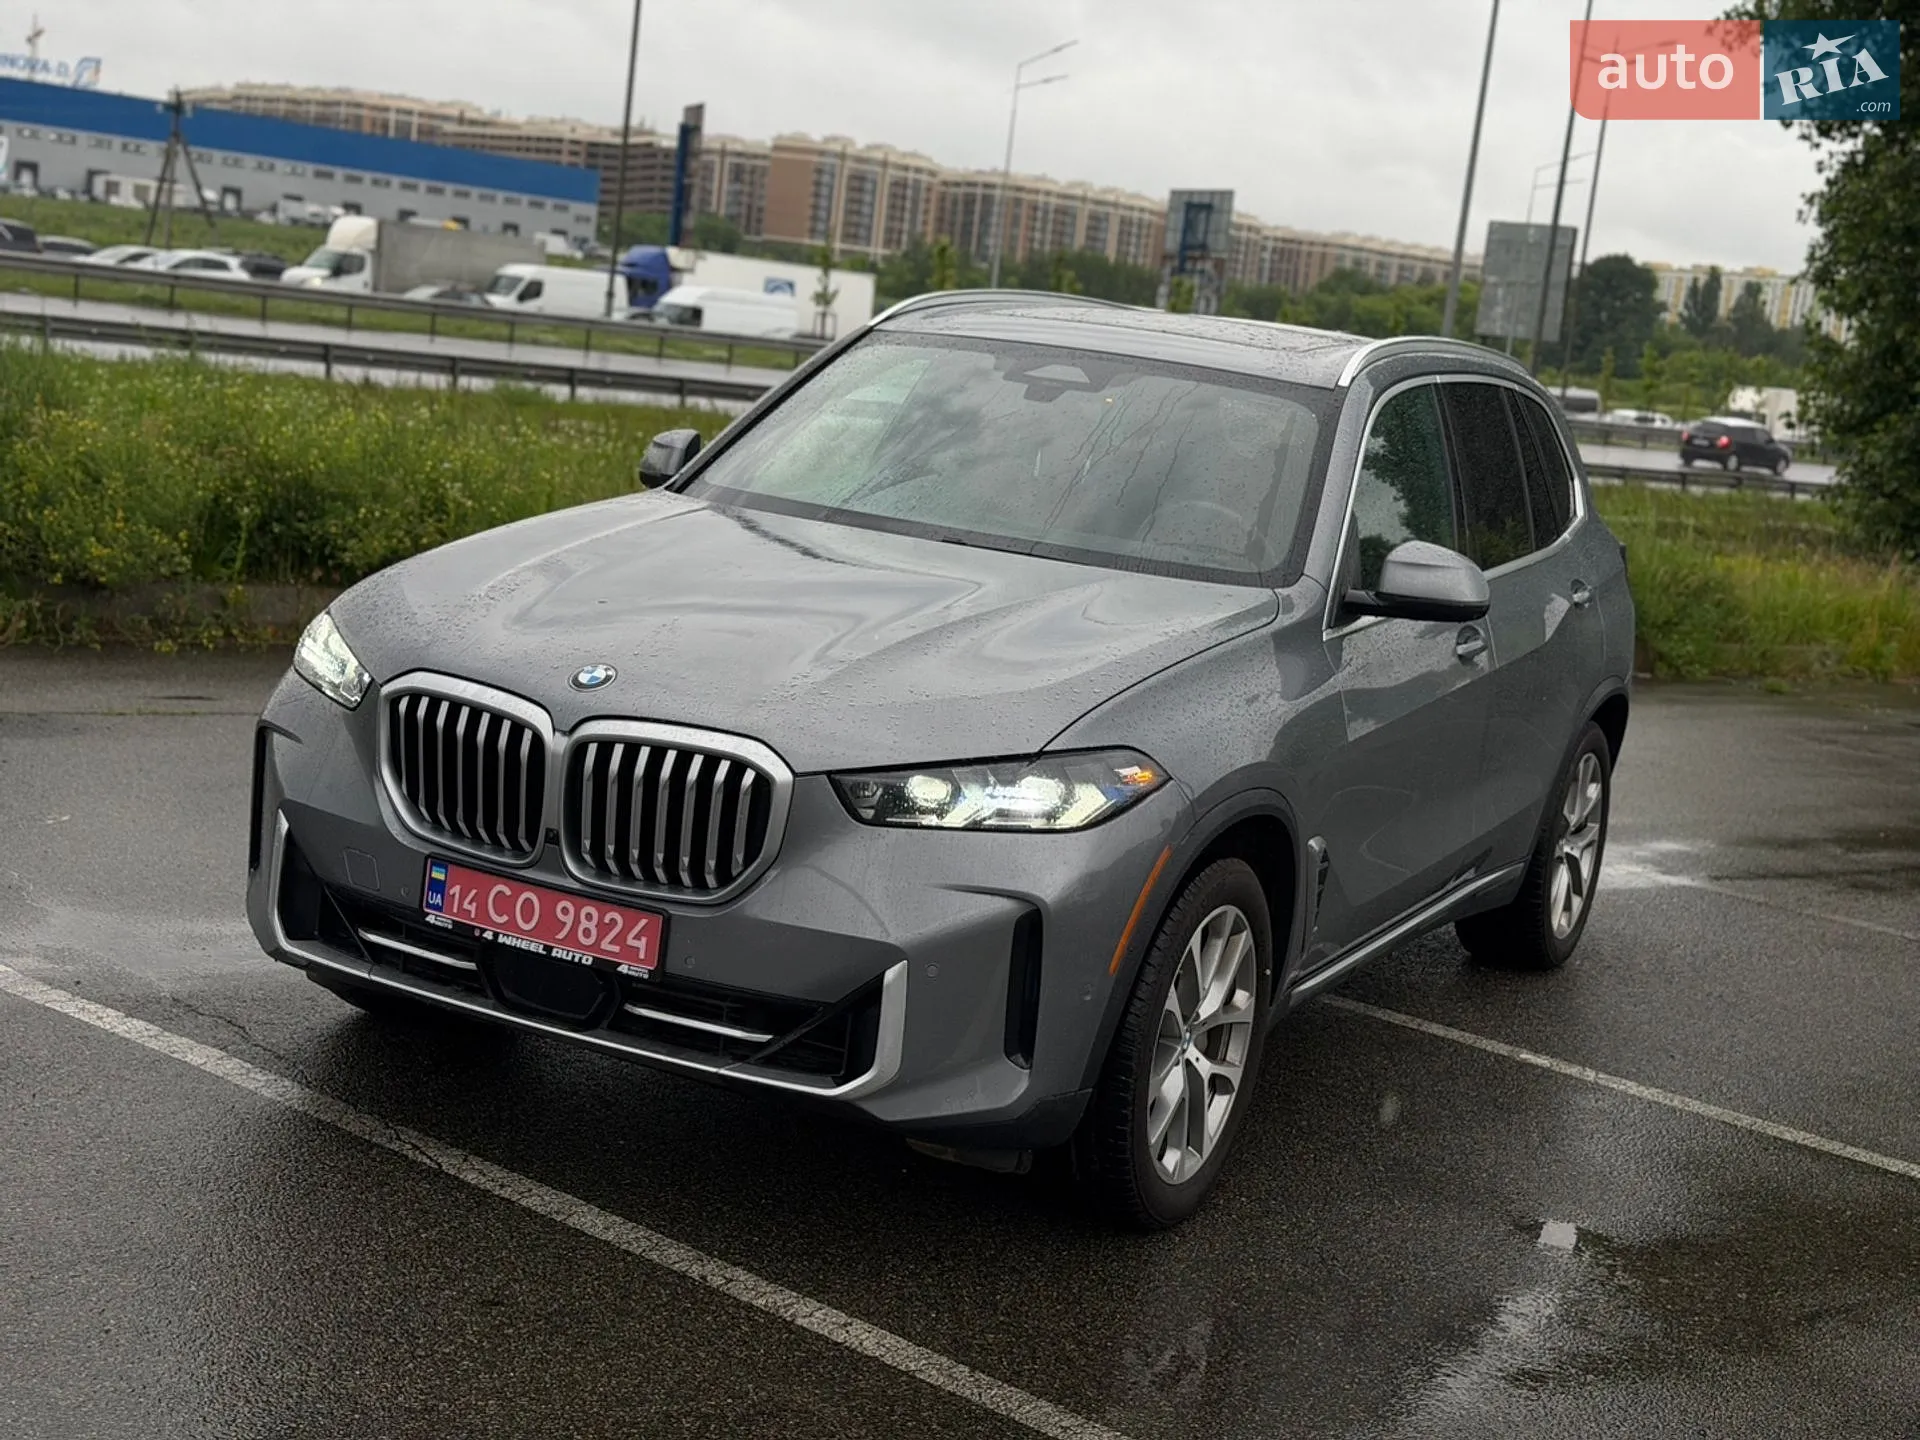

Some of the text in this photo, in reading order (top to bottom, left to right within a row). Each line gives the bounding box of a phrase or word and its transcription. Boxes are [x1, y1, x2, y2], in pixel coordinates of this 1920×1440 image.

[428, 889, 442, 906] UA
[449, 884, 649, 960] 14 CO 9824
[482, 930, 593, 966] 4 WHEEL AUTO
